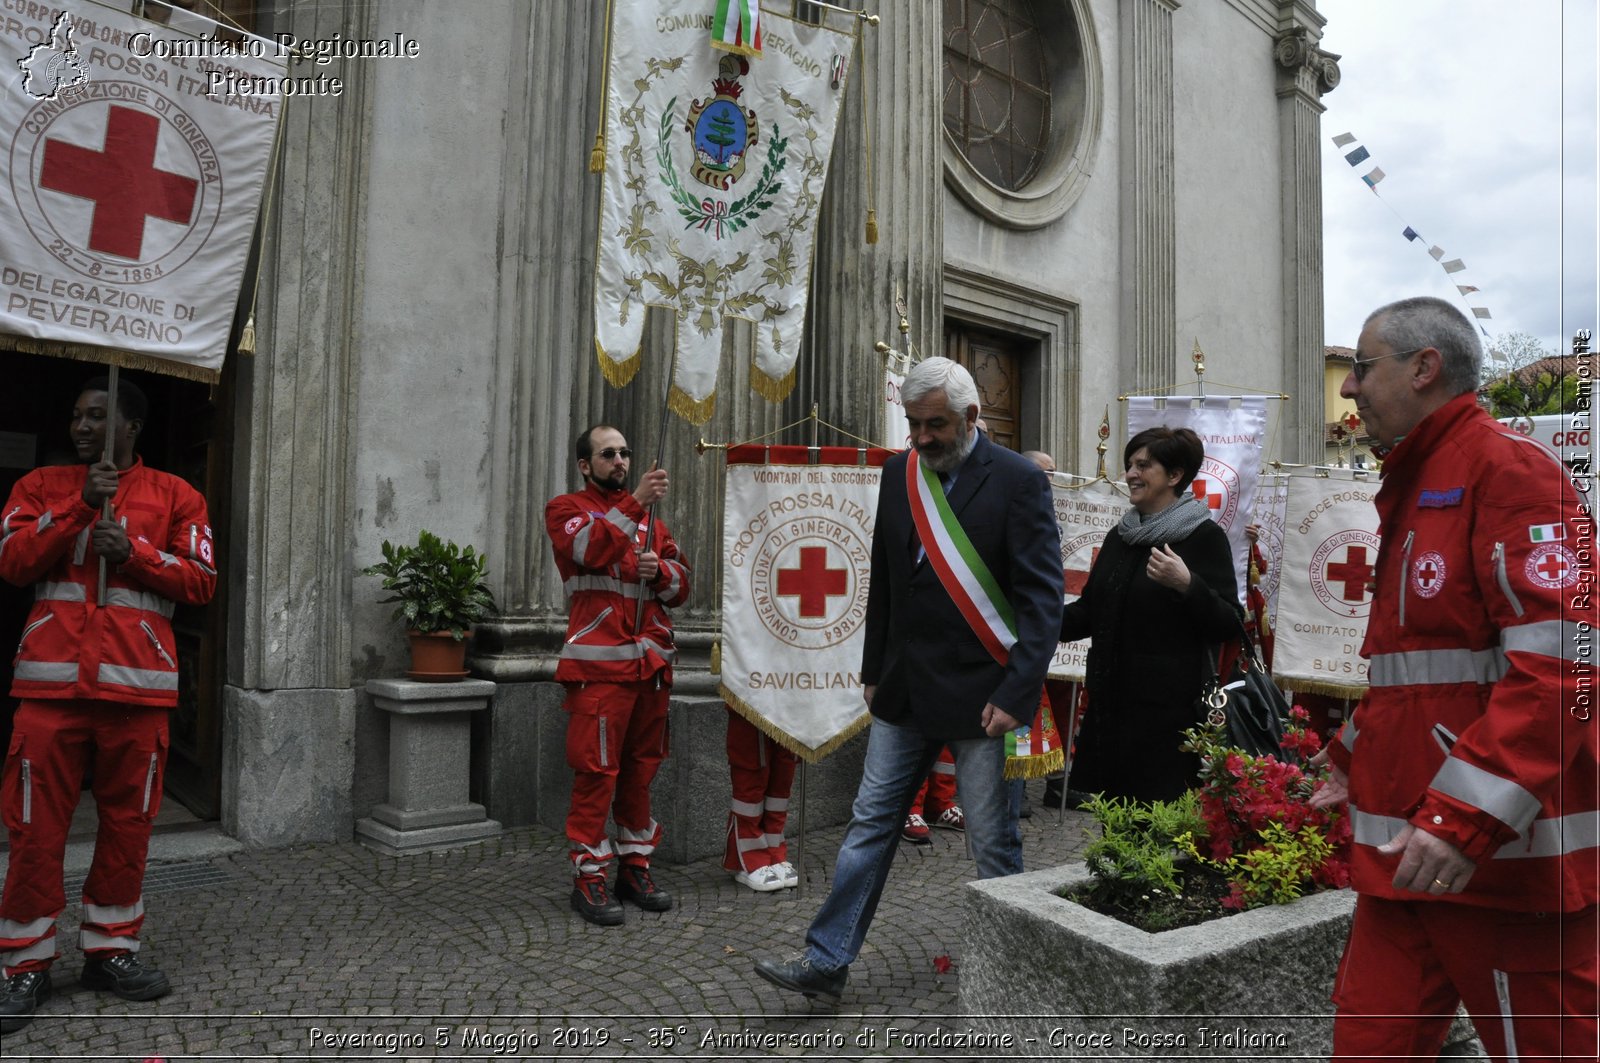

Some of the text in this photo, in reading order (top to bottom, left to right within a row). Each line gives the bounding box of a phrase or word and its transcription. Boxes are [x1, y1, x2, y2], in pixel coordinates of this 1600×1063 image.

[88, 46, 169, 87] ROSSA
[155, 97, 171, 115] DI
[173, 113, 219, 184] GINEVRA
[1, 266, 196, 322] DELEGAZIONE DI
[7, 292, 183, 345] PEVERAGNO
[1211, 434, 1257, 445] ITALIANA
[807, 472, 827, 484] DEL
[831, 472, 878, 485] SOCCORSO
[1298, 491, 1376, 536] CROCE ROSSA
[730, 510, 769, 568] CROCE
[769, 492, 835, 519] ROSSA
[771, 532, 787, 547] DI
[791, 520, 851, 547] GINEVRA
[850, 547, 866, 564] 22
[1061, 533, 1106, 559] NVENZIONE
[1312, 532, 1379, 604] CONVENZIONE DI GINEVRA
[754, 549, 798, 642] CONVENZIONE
[824, 617, 856, 642] 1864
[1293, 623, 1357, 638] COMITATO
[1343, 643, 1357, 655] DI
